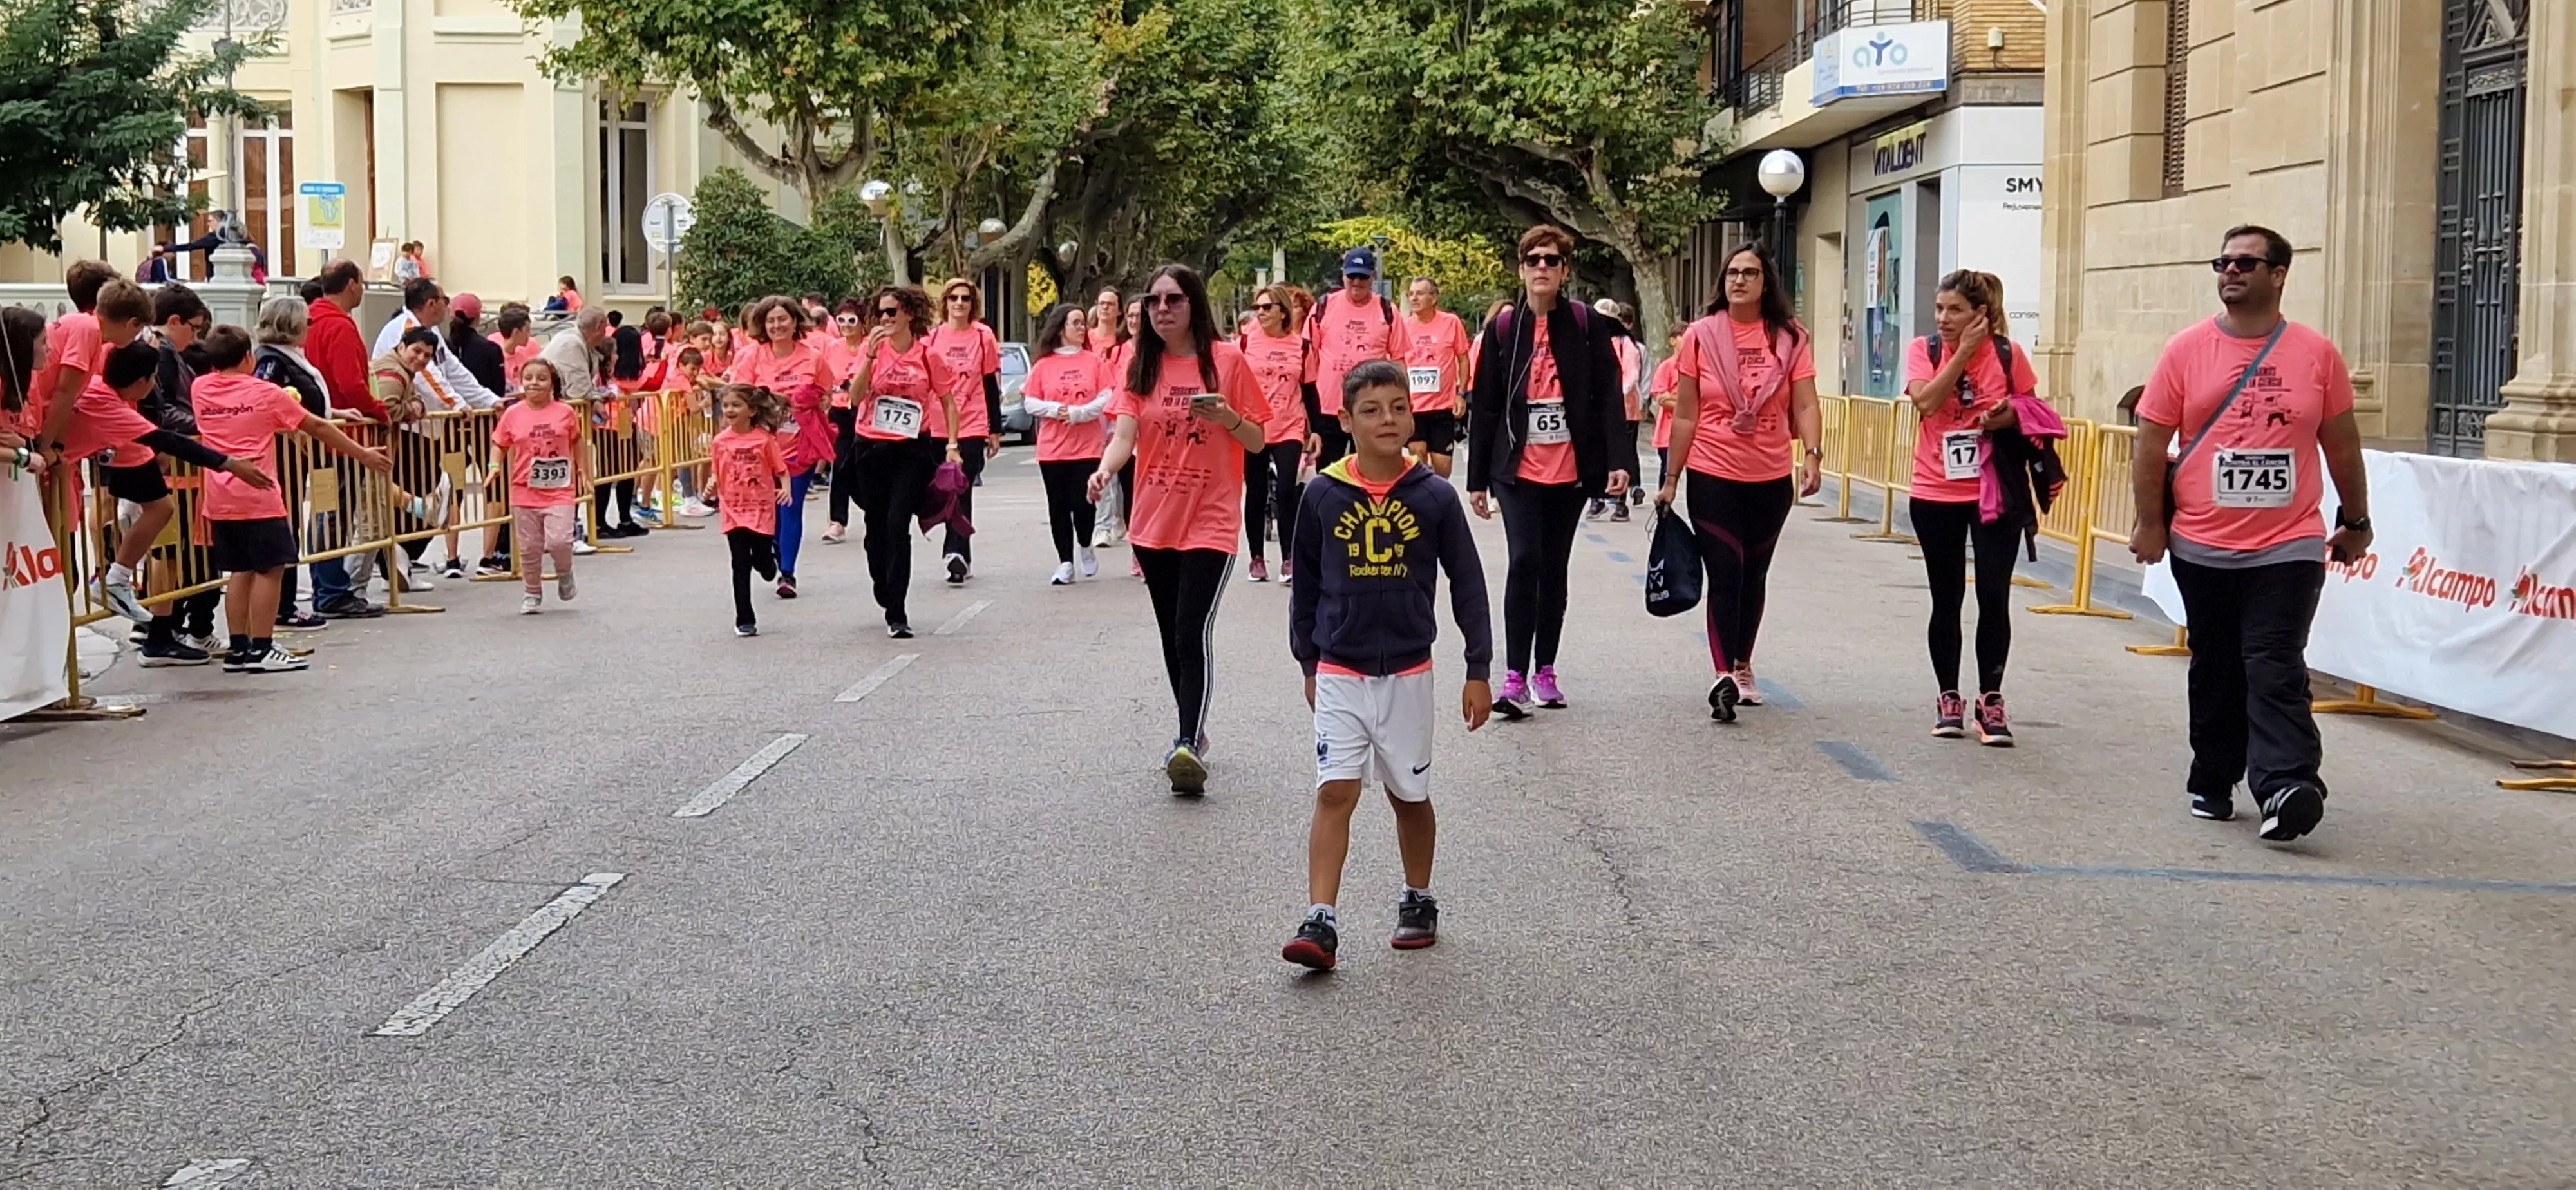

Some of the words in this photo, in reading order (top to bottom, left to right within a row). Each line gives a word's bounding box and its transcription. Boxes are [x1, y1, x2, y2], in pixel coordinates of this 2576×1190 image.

[884, 408, 912, 426] 175
[1537, 414, 1566, 431] 65
[531, 467, 566, 480] 3393
[2222, 469, 2287, 491] 1745
[1334, 497, 1421, 542] CHAMPION
[1347, 543, 1360, 558] 19
[1365, 518, 1393, 563] C
[2395, 547, 2496, 612] Alcampo
